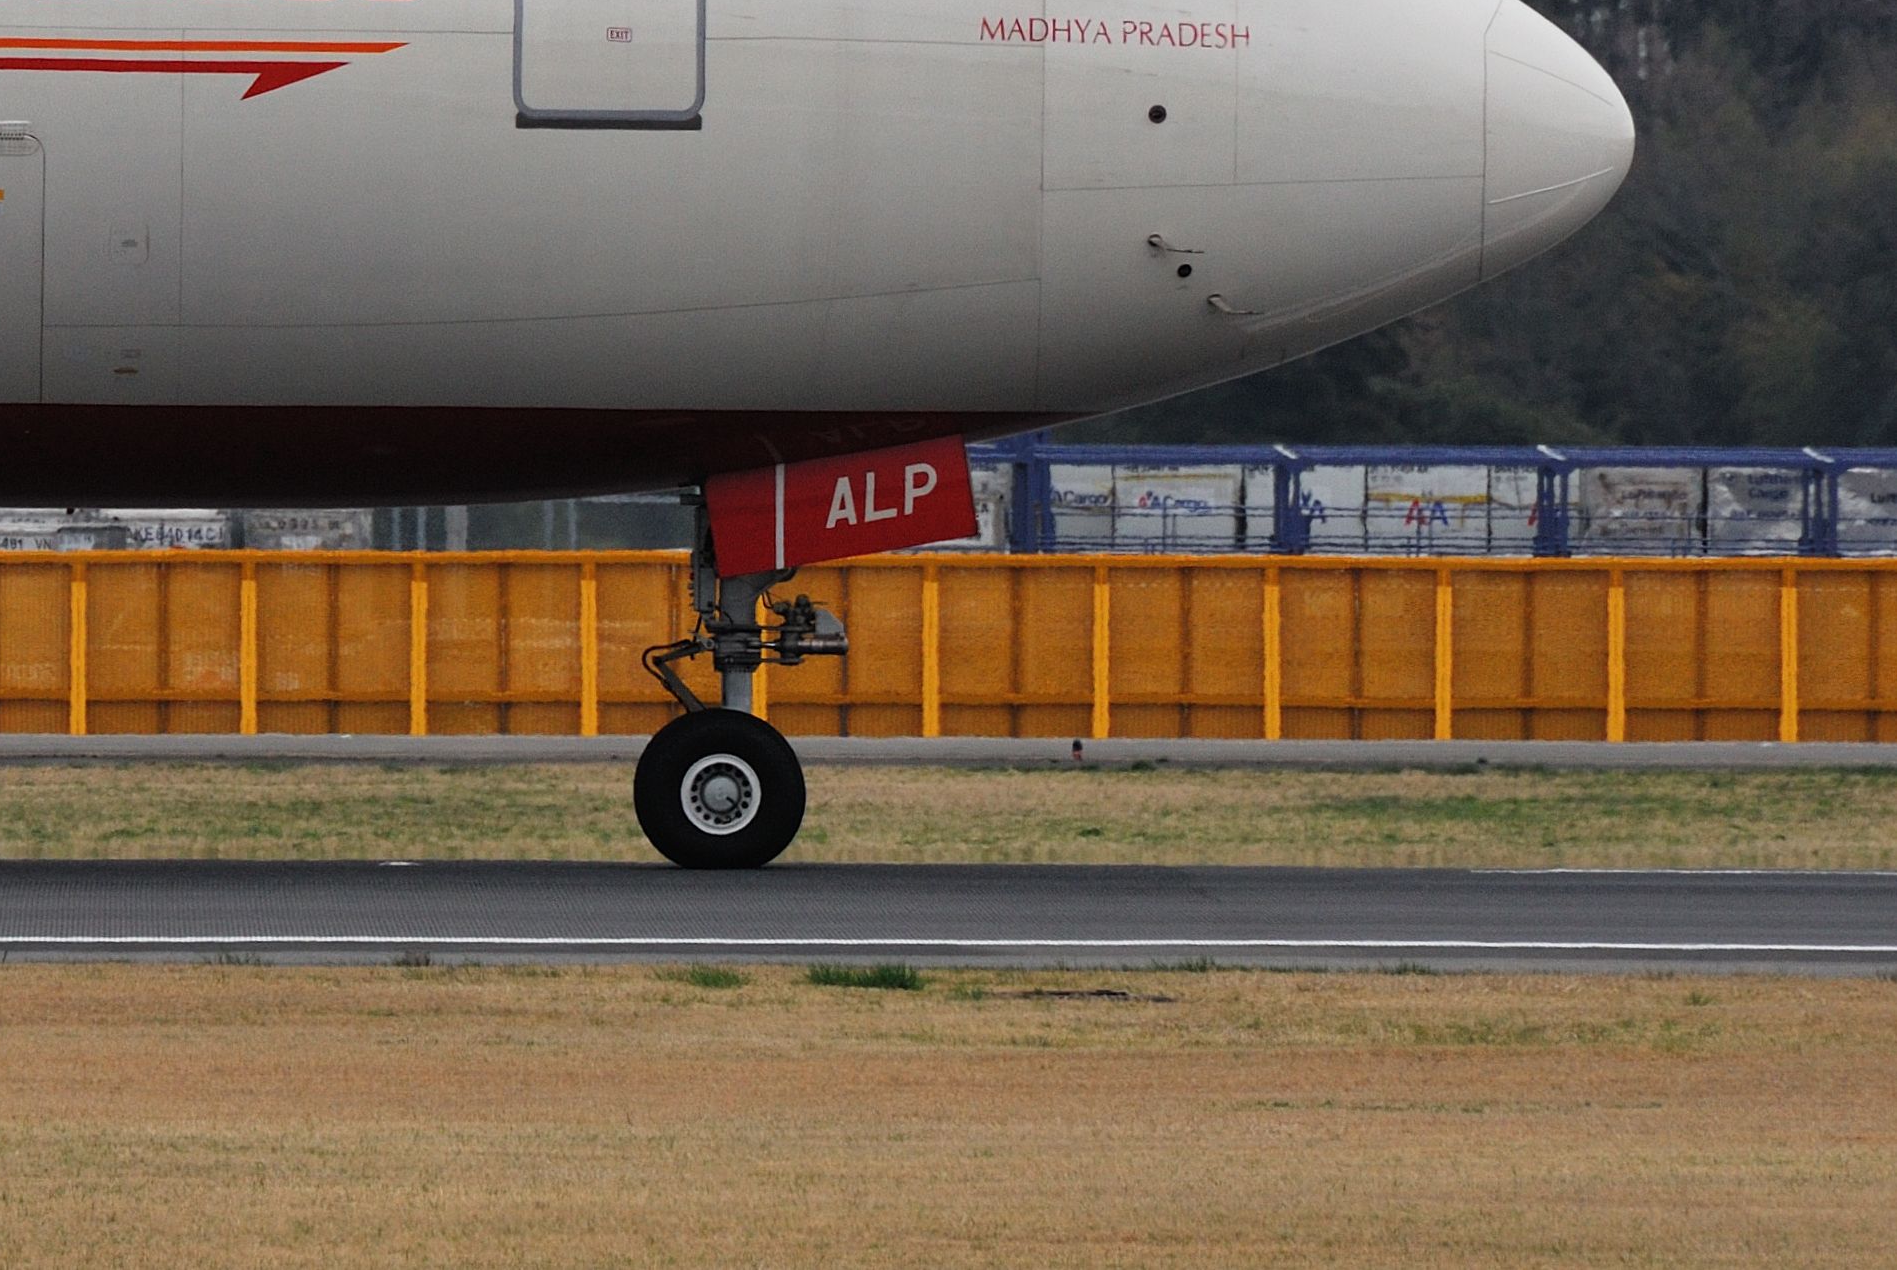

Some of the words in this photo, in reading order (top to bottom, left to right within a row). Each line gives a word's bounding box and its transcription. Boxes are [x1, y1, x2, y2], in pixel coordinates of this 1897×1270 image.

[609, 30, 629, 41] EXIT
[979, 15, 1112, 46] MADHYA
[1121, 19, 1251, 50] PRADESH
[825, 462, 939, 530] ALP
[1064, 490, 1108, 506] Cargo
[1404, 497, 1449, 526] AA
[34, 537, 52, 550] VN
